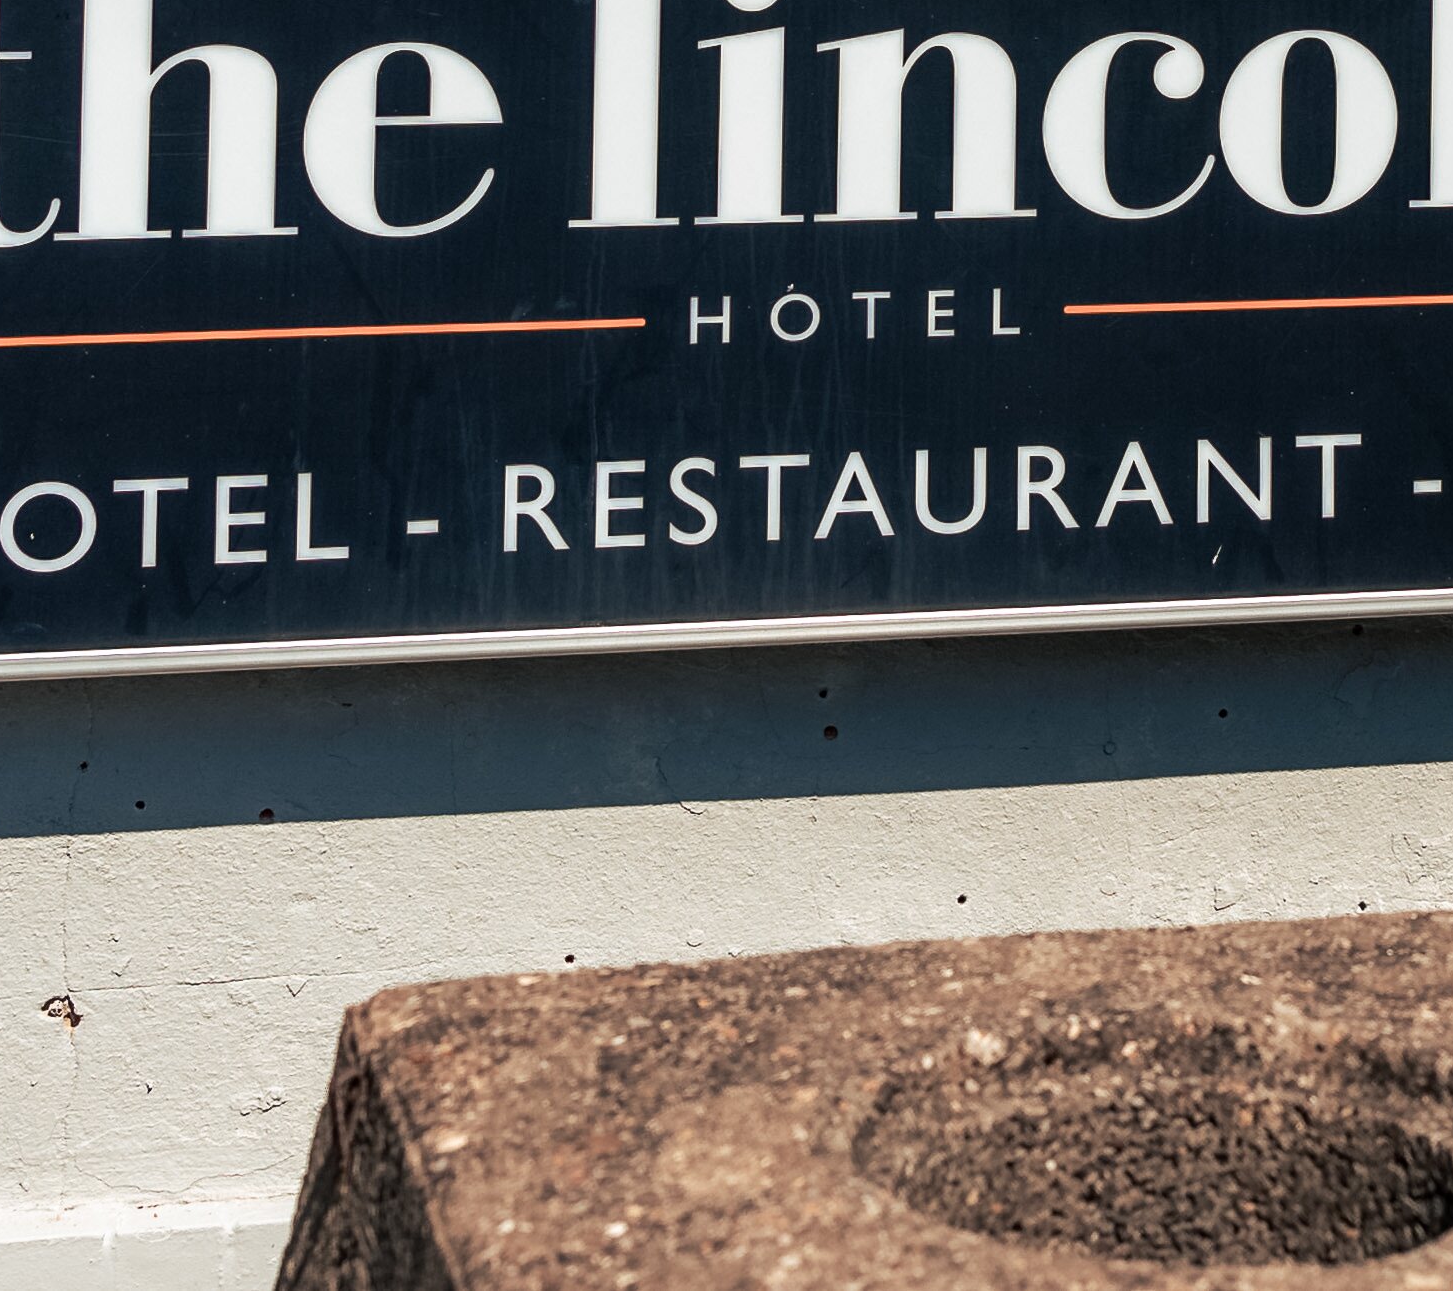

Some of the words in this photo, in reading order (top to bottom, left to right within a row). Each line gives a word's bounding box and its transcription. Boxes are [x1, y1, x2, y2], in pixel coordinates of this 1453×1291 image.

[688, 287, 1022, 346] HOTEL
[405, 518, 440, 536] -
[502, 432, 1363, 554] RESTAURANT
[1412, 478, 1443, 495] -
